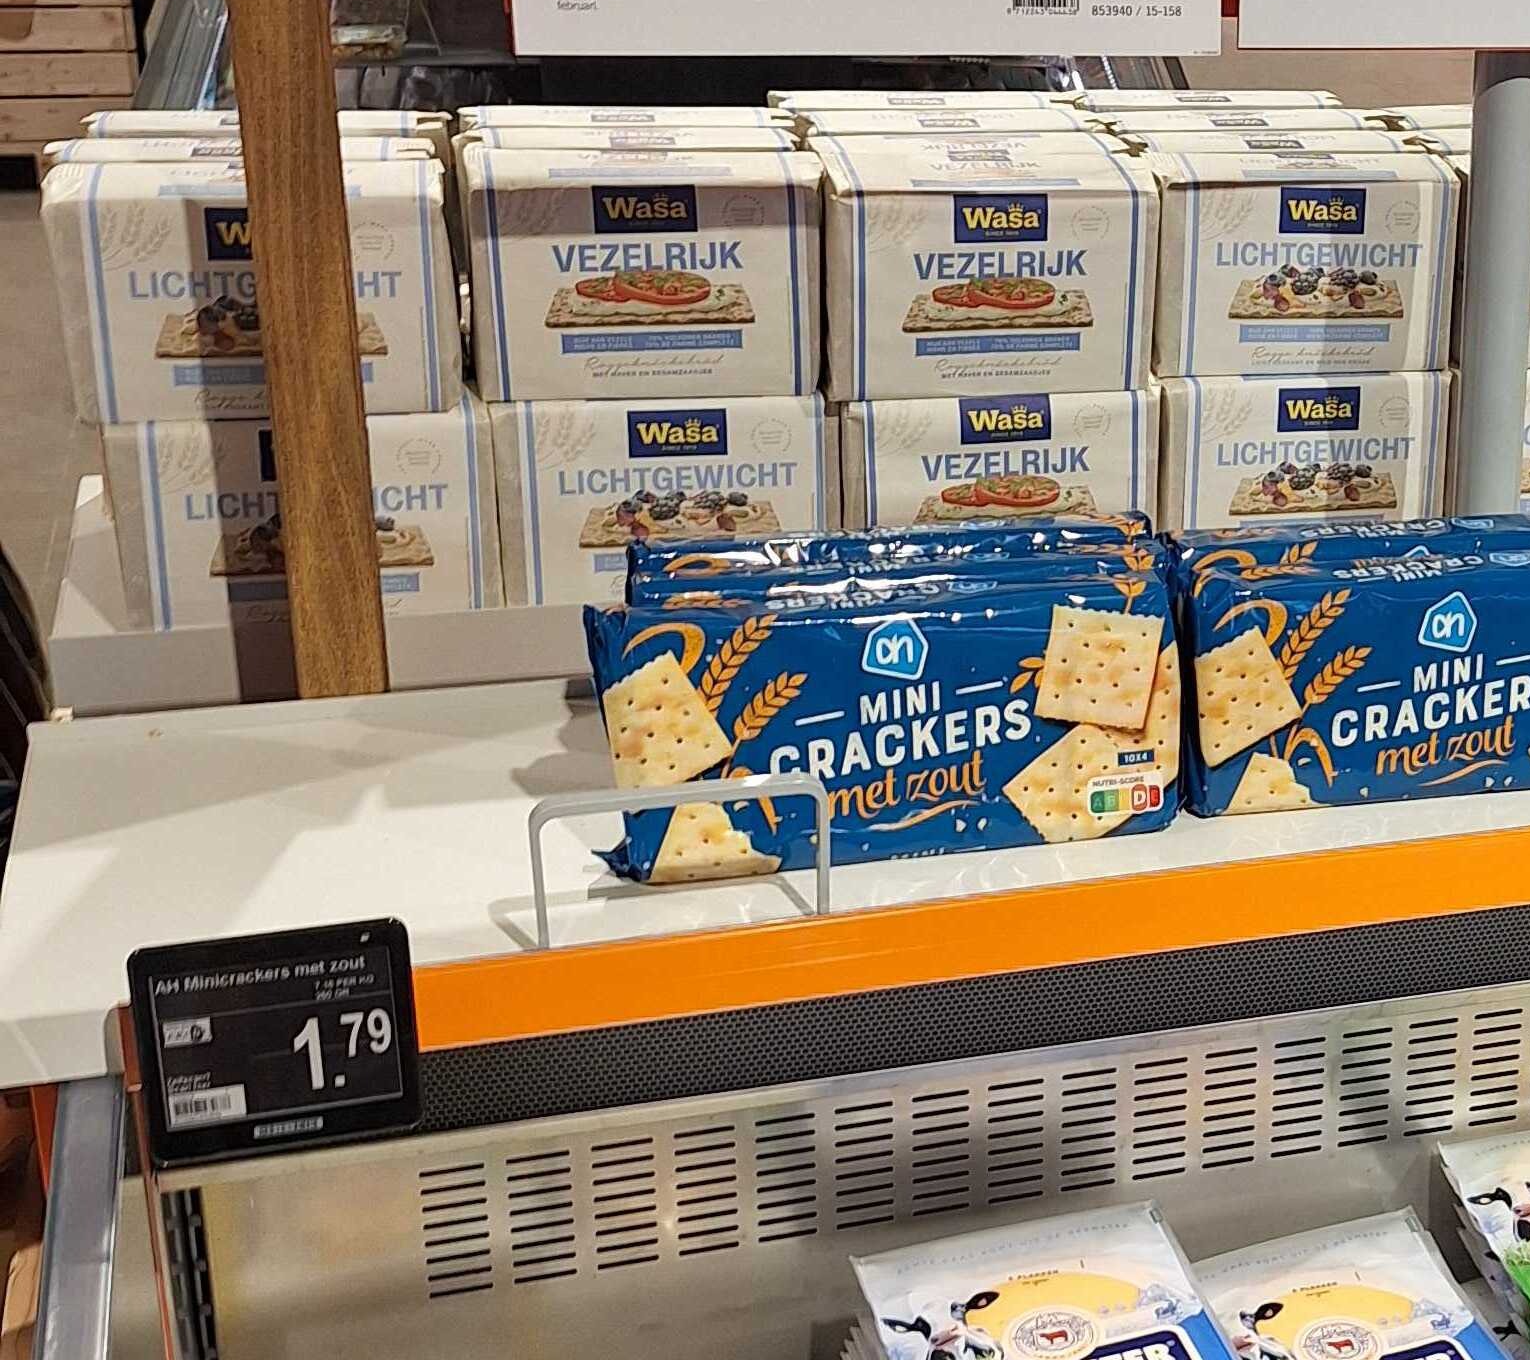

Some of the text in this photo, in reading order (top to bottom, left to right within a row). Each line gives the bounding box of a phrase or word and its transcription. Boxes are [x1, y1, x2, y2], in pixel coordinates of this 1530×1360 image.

[1091, 4, 1133, 18] 853940
[1145, 4, 1182, 18] 15-158
[603, 193, 689, 222] Wasa
[962, 202, 1040, 232] Wasa
[1287, 196, 1359, 223] Wasa
[552, 240, 744, 274] VEZELRIJK
[914, 249, 1088, 282] VEZELRIJK
[1216, 241, 1424, 268] LICHTGEWICHT
[635, 416, 719, 447] Wasa
[559, 462, 798, 497] LICHTGEWICHT
[860, 680, 941, 726] MINI
[770, 698, 1033, 780] CRACKERS
[1123, 752, 1149, 764] 10X4
[829, 749, 988, 821] met zout
[184, 965, 290, 992] Minicrackers
[294, 959, 325, 977] met
[329, 955, 366, 974] zout
[293, 1007, 392, 1091] 1.79
